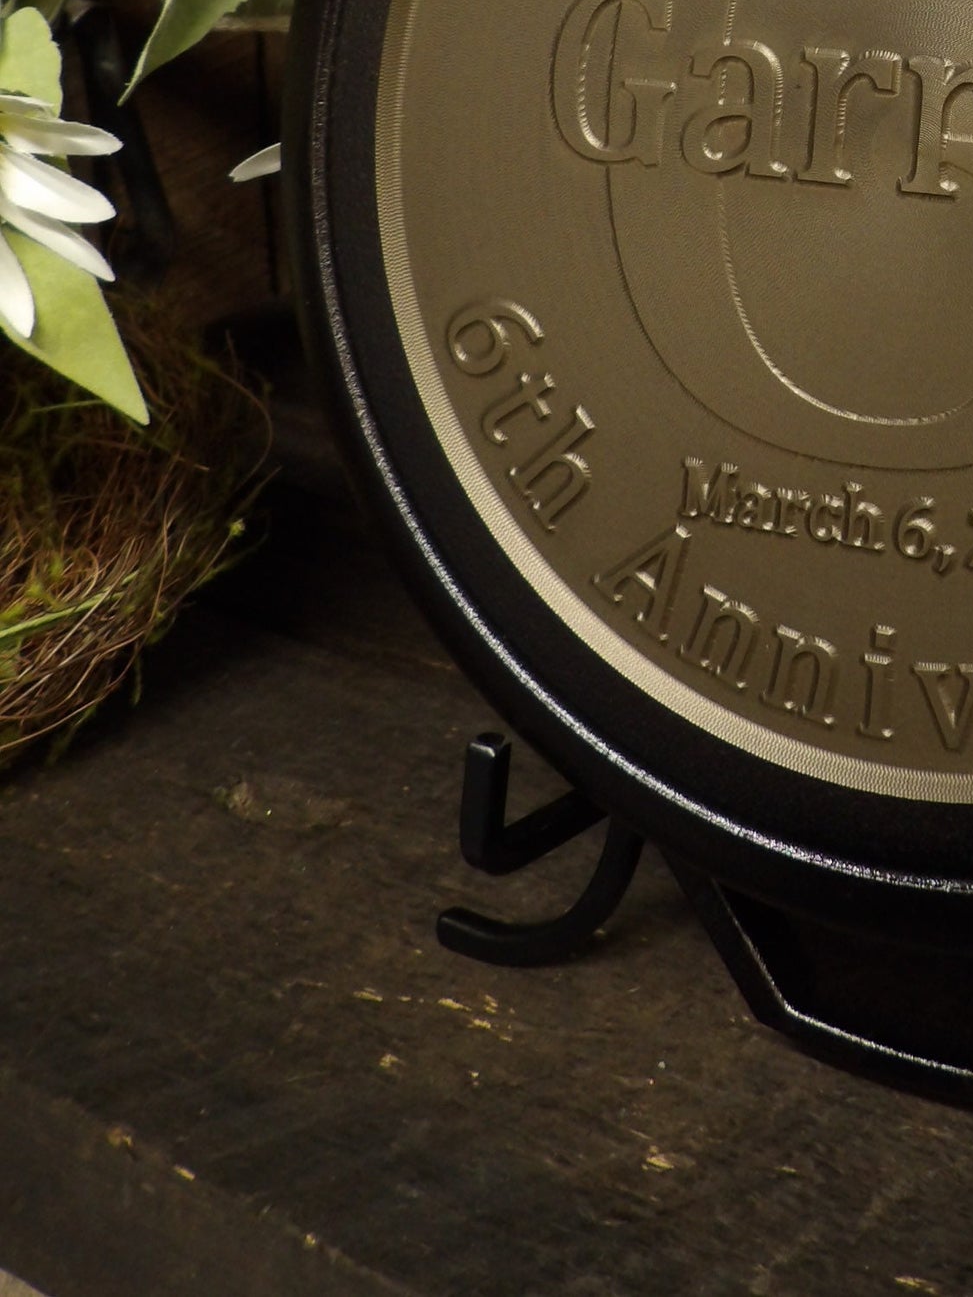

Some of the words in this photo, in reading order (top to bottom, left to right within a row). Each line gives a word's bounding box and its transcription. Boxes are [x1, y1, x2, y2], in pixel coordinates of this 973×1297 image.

[447, 302, 596, 533] 6th
[679, 457, 885, 551] March
[893, 497, 956, 574] 6,
